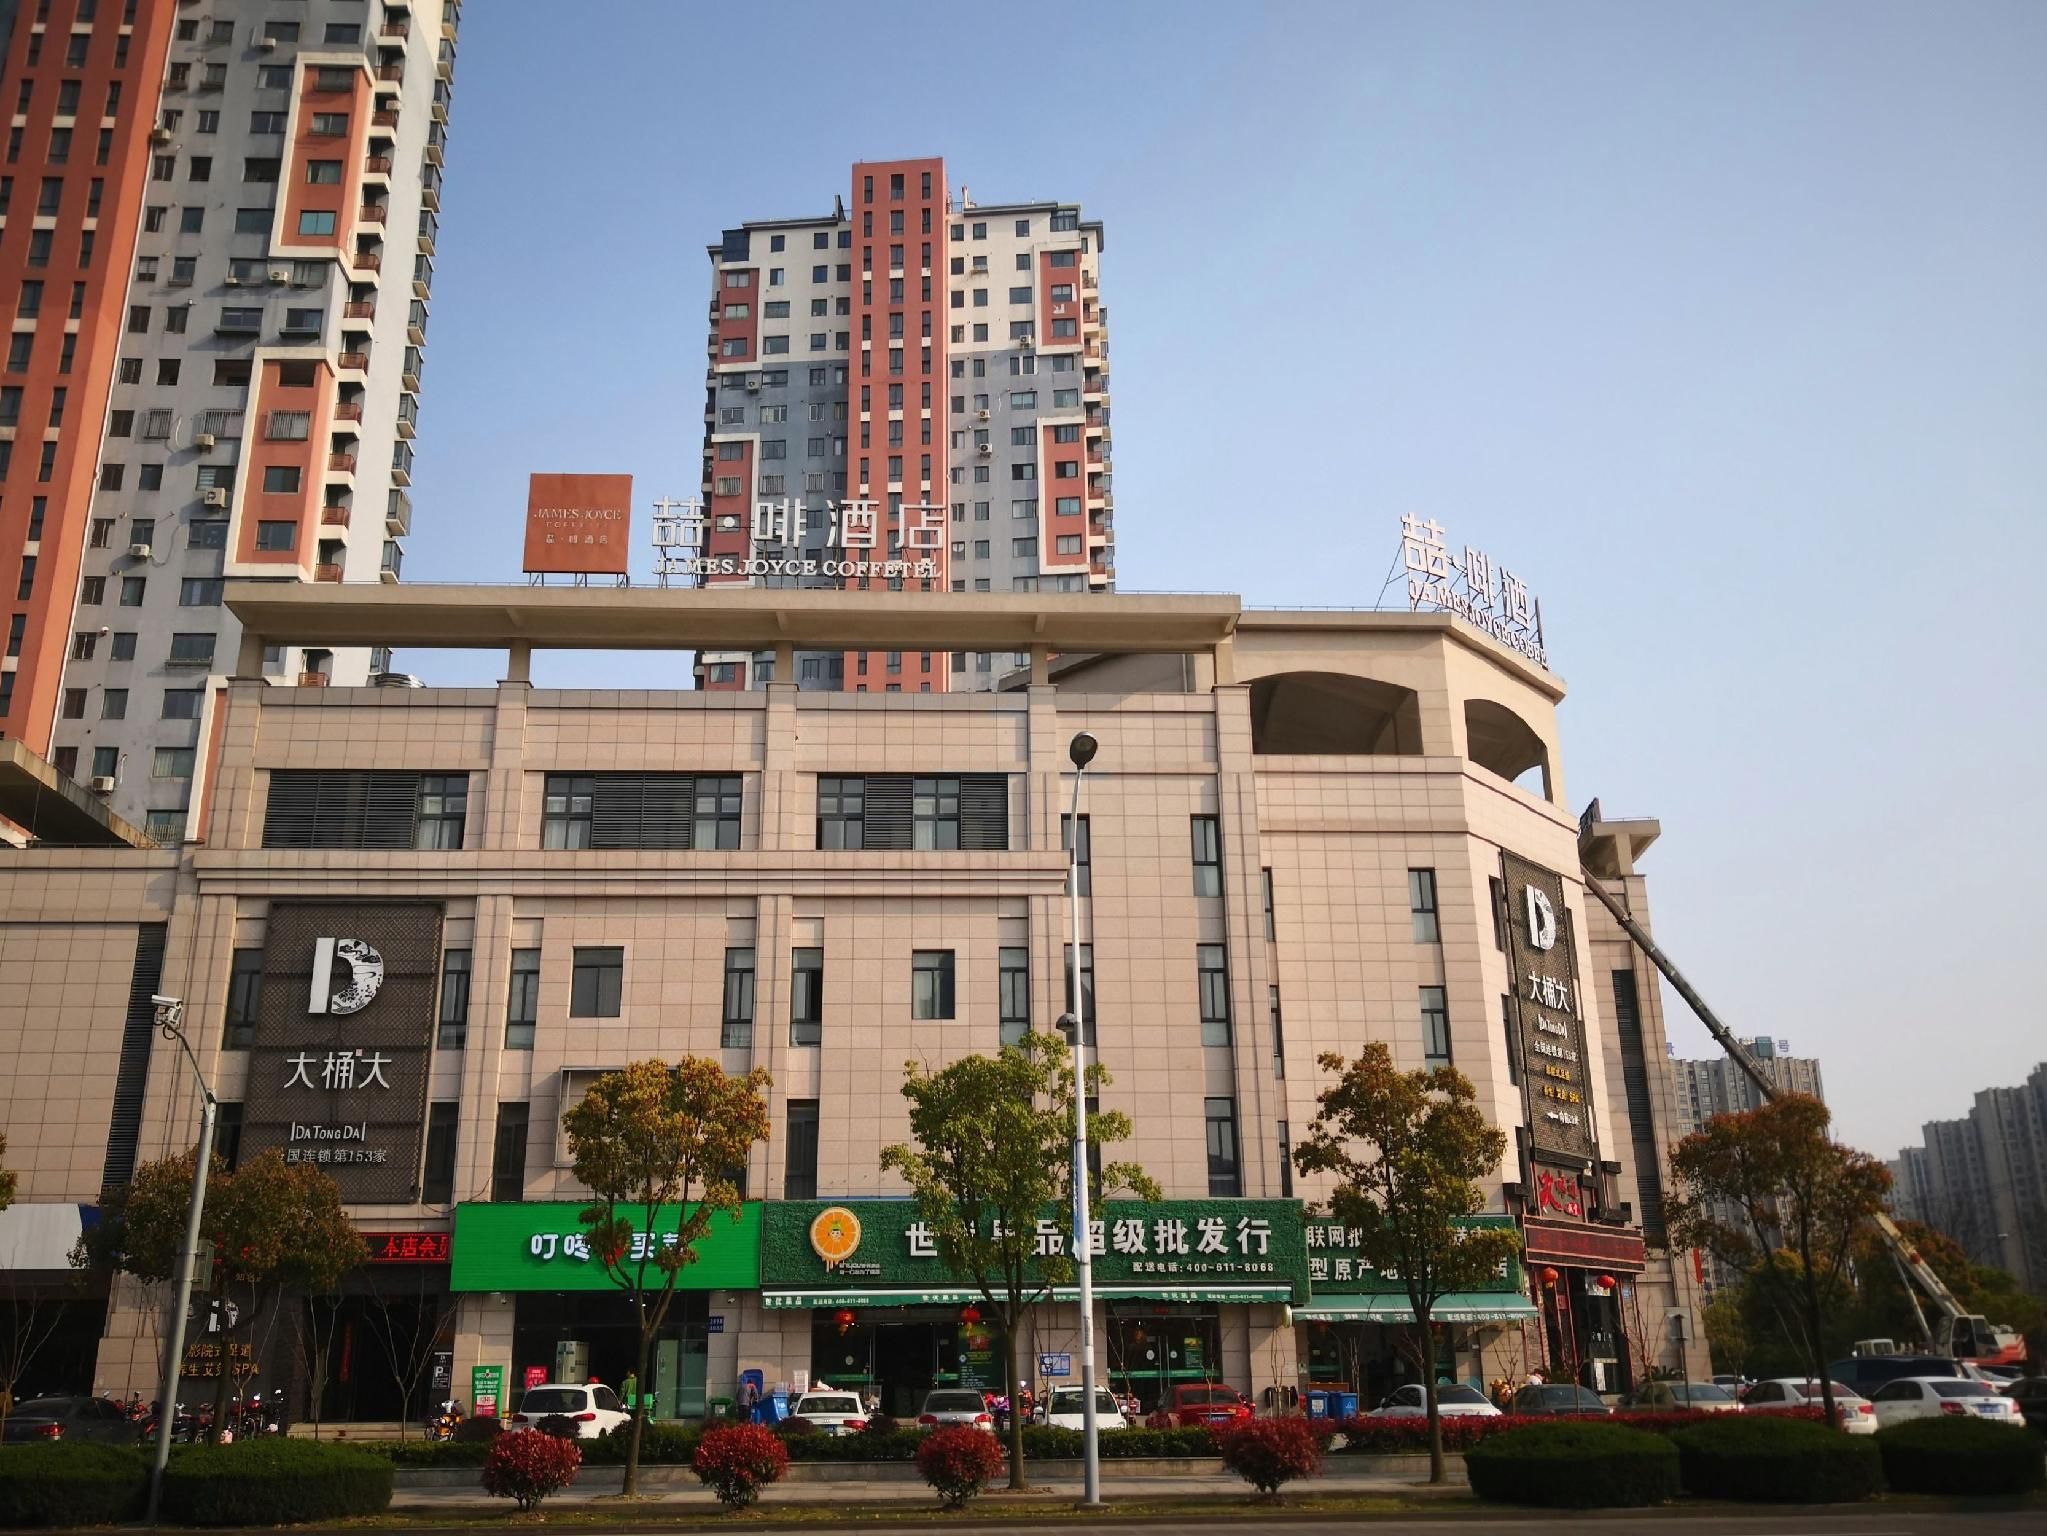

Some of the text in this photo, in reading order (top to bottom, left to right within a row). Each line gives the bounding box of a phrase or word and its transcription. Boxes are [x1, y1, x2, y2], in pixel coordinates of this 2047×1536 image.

[534, 508, 622, 520] JAMES JOYCE
[652, 558, 943, 578] JAMES JOYCE COFFETEL
[1528, 971, 1571, 1012] 大桶大
[284, 1051, 393, 1089] 大桶大
[279, 1148, 387, 1163] 国连锁第153家
[904, 1217, 1272, 1256] 世品级批发行
